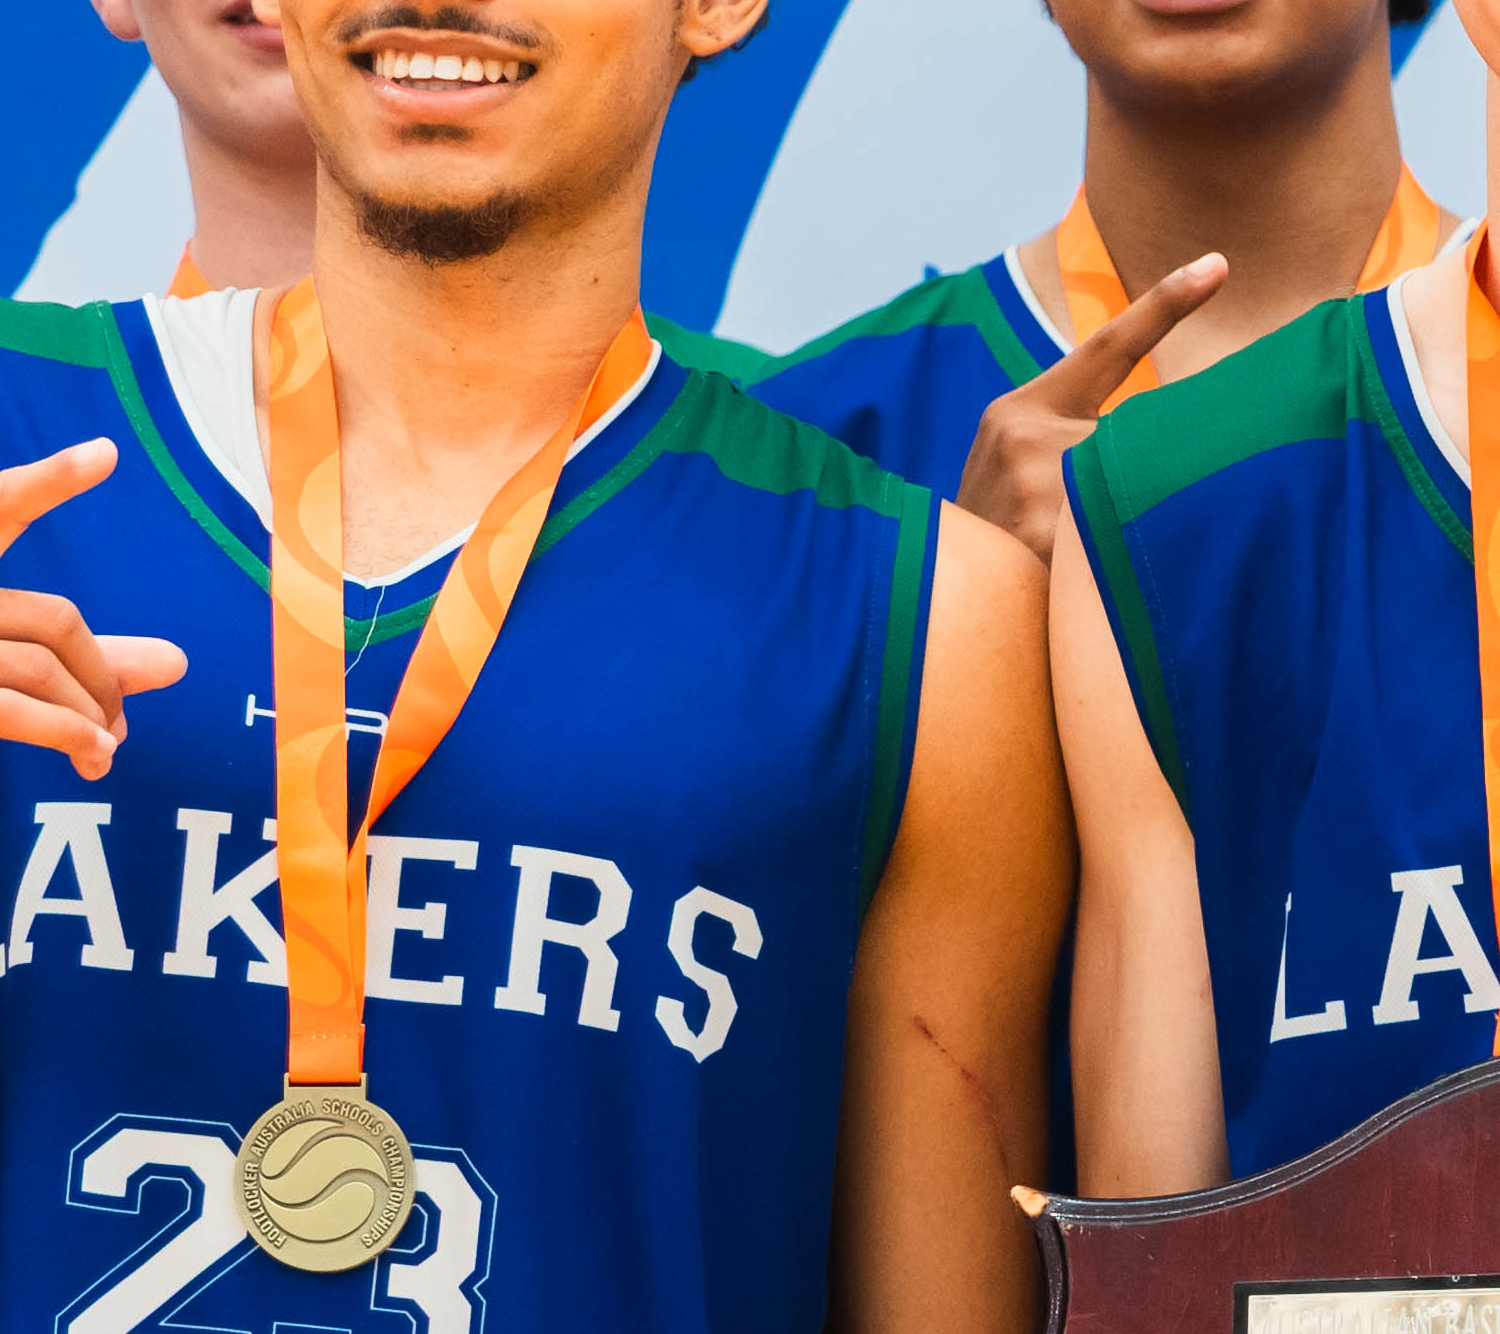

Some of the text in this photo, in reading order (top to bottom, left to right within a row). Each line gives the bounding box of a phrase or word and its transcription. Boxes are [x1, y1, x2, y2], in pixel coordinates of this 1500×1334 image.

[243, 1098, 406, 1249] FOOTLOCKER AUSTRALIA SCHOOLS CHAMPIONSHIPS
